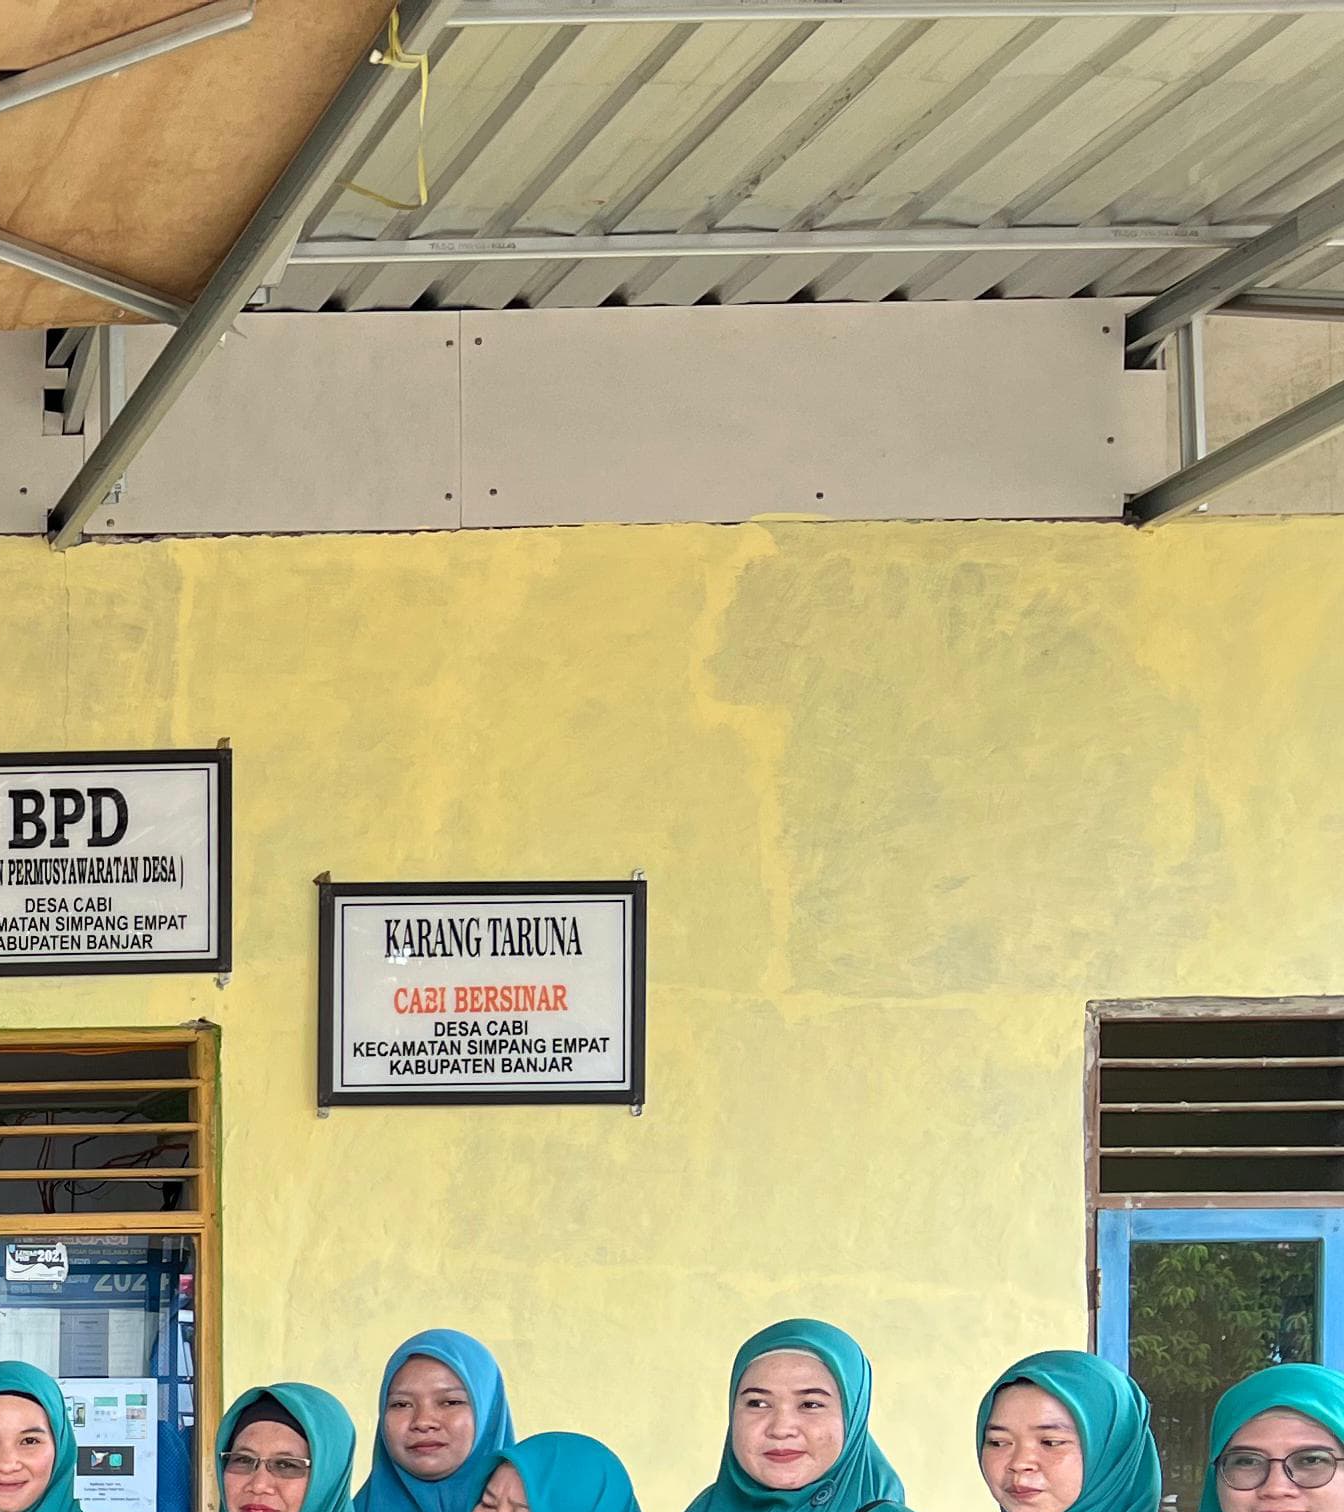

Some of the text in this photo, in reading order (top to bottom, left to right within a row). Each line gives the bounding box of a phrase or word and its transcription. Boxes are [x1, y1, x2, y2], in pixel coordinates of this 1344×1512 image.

[8, 787, 129, 849] BPD
[8, 856, 139, 886] PERMUSYAWARATAN
[143, 856, 177, 882] DESA
[25, 897, 112, 913] DESA CABI
[55, 916, 128, 931] SIMPANG
[134, 914, 187, 930] EMPAT
[87, 934, 153, 950] BANJAR
[384, 917, 583, 958] KARANG TARUNA
[394, 985, 568, 1014] CABI BERSINAR
[434, 1020, 528, 1037] DESA CABI
[353, 1037, 610, 1057] KECAMATAN SIMPANG EMPAT
[389, 1057, 573, 1075] KABUPATEN BANJAR
